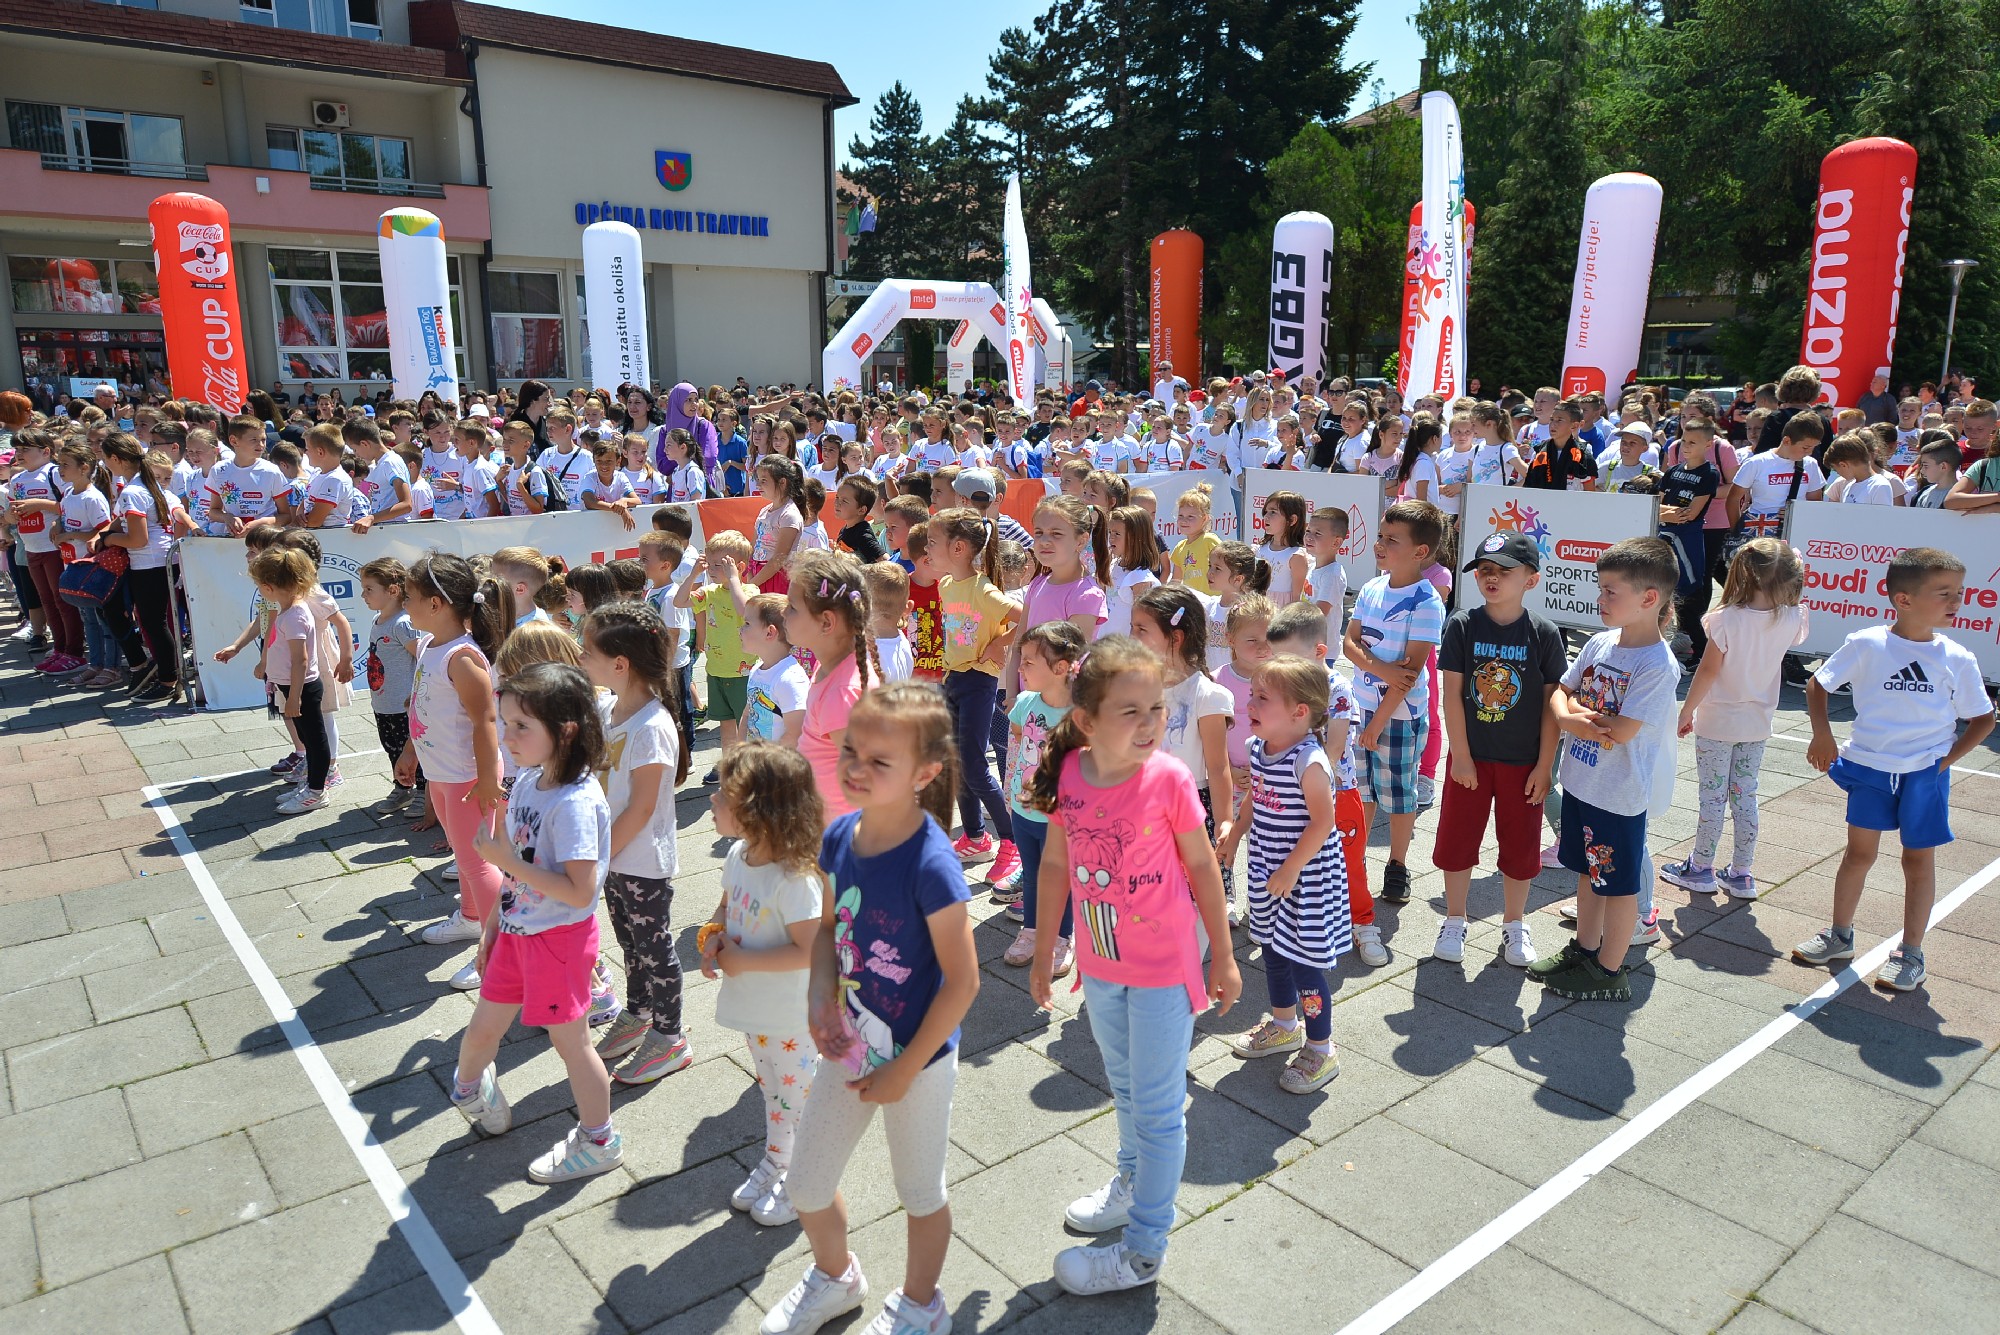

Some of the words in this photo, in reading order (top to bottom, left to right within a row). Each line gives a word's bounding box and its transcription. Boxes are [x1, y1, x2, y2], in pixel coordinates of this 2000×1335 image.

[575, 201, 646, 229] OPĆINA
[650, 208, 692, 232] NOVI
[696, 211, 769, 237] TRAVNIK
[181, 224, 221, 240] Coca-Cola
[196, 265, 220, 275] CUP
[1582, 219, 1601, 300] prijatelje!
[611, 256, 625, 303] okoliša
[1153, 267, 1161, 309] BANKA
[421, 308, 430, 323] Joy
[202, 298, 233, 360] CUP
[425, 326, 435, 334] of
[433, 306, 446, 347] Kinder
[616, 307, 629, 351] zaštitu
[1575, 305, 1591, 349] imate
[428, 336, 438, 363] moving
[633, 334, 641, 352] BiH
[621, 354, 630, 368] za
[634, 353, 643, 387] eracije
[1769, 475, 1808, 485] ŠAIME
[1560, 543, 1604, 559] plazm
[1807, 540, 1858, 561] ZERO
[1545, 565, 1599, 583] SPORTS
[1804, 564, 1868, 594] budi
[1545, 581, 1576, 597] IGRE
[1545, 596, 1600, 616] MLADIH
[1800, 596, 1878, 619] čuvajmo
[1474, 642, 1528, 661] RUH-ROH!
[914, 656, 943, 671] VENGE
[1883, 679, 1934, 694] adidas
[1570, 743, 1598, 768] HERO
[1129, 869, 1163, 894] your
